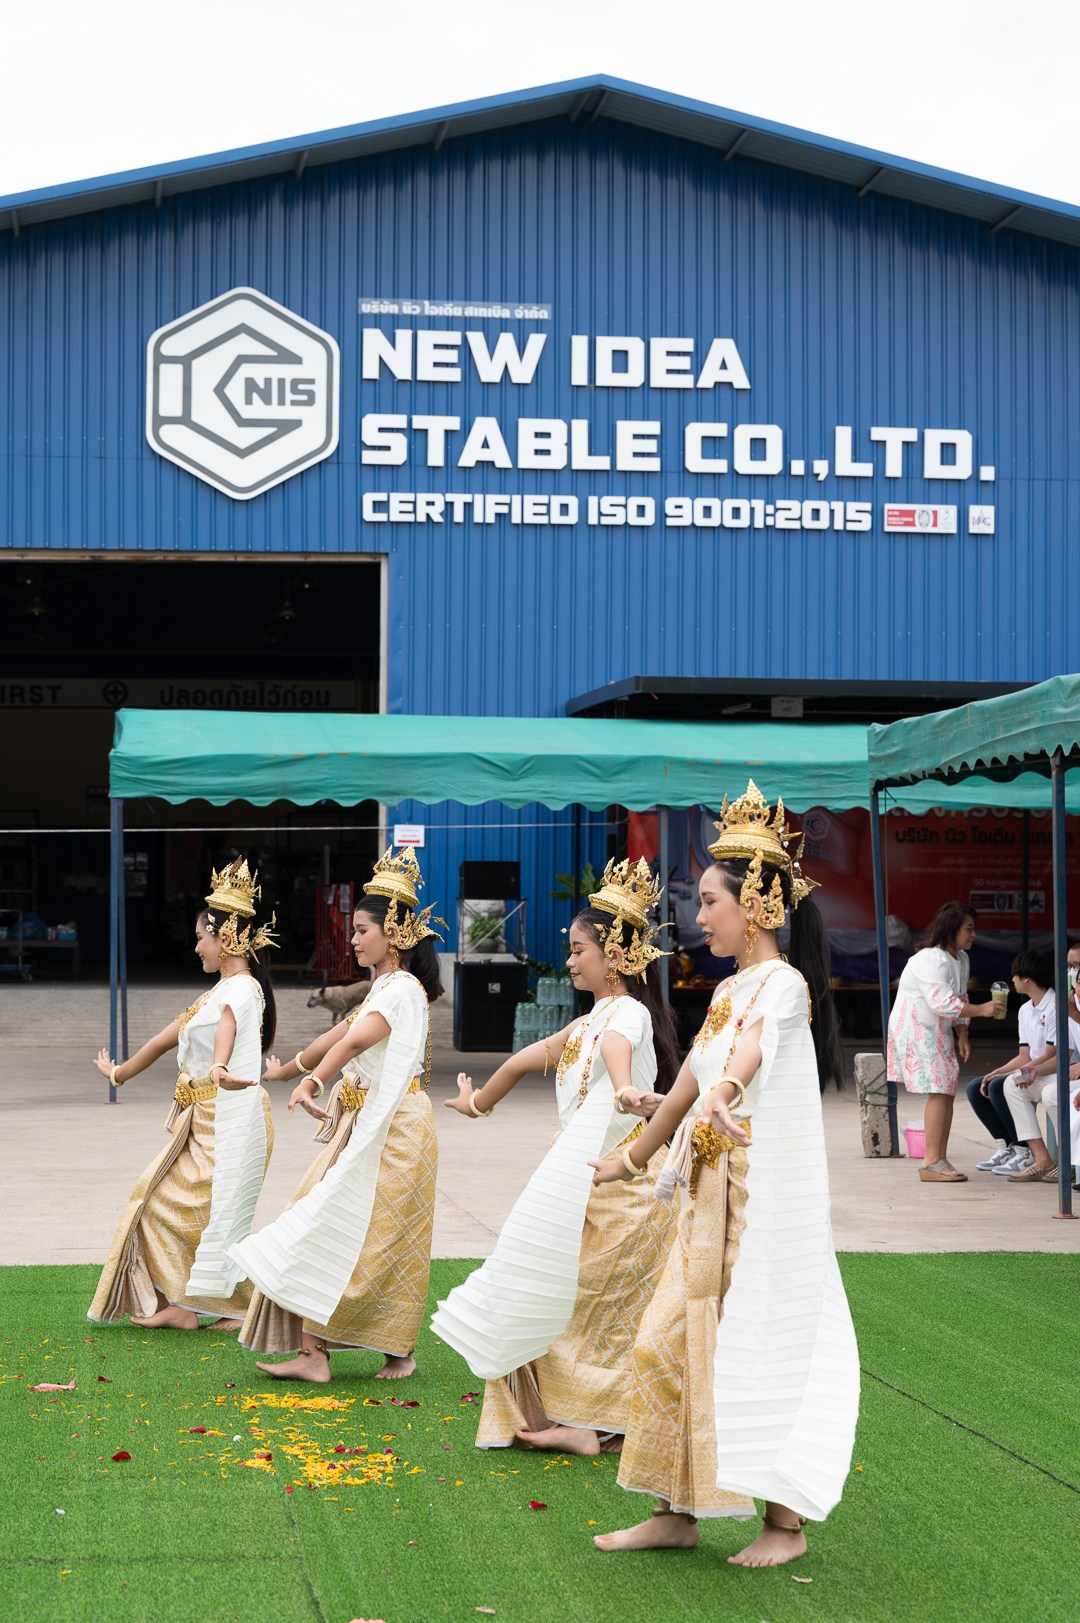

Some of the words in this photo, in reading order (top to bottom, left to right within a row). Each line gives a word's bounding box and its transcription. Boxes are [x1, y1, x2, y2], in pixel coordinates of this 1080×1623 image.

[361, 300, 399, 314] บริษัท
[402, 301, 421, 315] นิว
[514, 305, 549, 319] จำกัด
[362, 328, 547, 384] NEW
[571, 335, 751, 389] IDEA
[244, 377, 316, 407] NIS
[361, 413, 661, 471] STABLE
[362, 492, 578, 525] CERTIFIED
[588, 496, 655, 525] ISO
[665, 497, 872, 531] 9001:2015
[0, 684, 62, 704] IRST
[159, 681, 331, 706] ปลอดภัยไว้ก่อน
[895, 826, 940, 844] บริษัท
